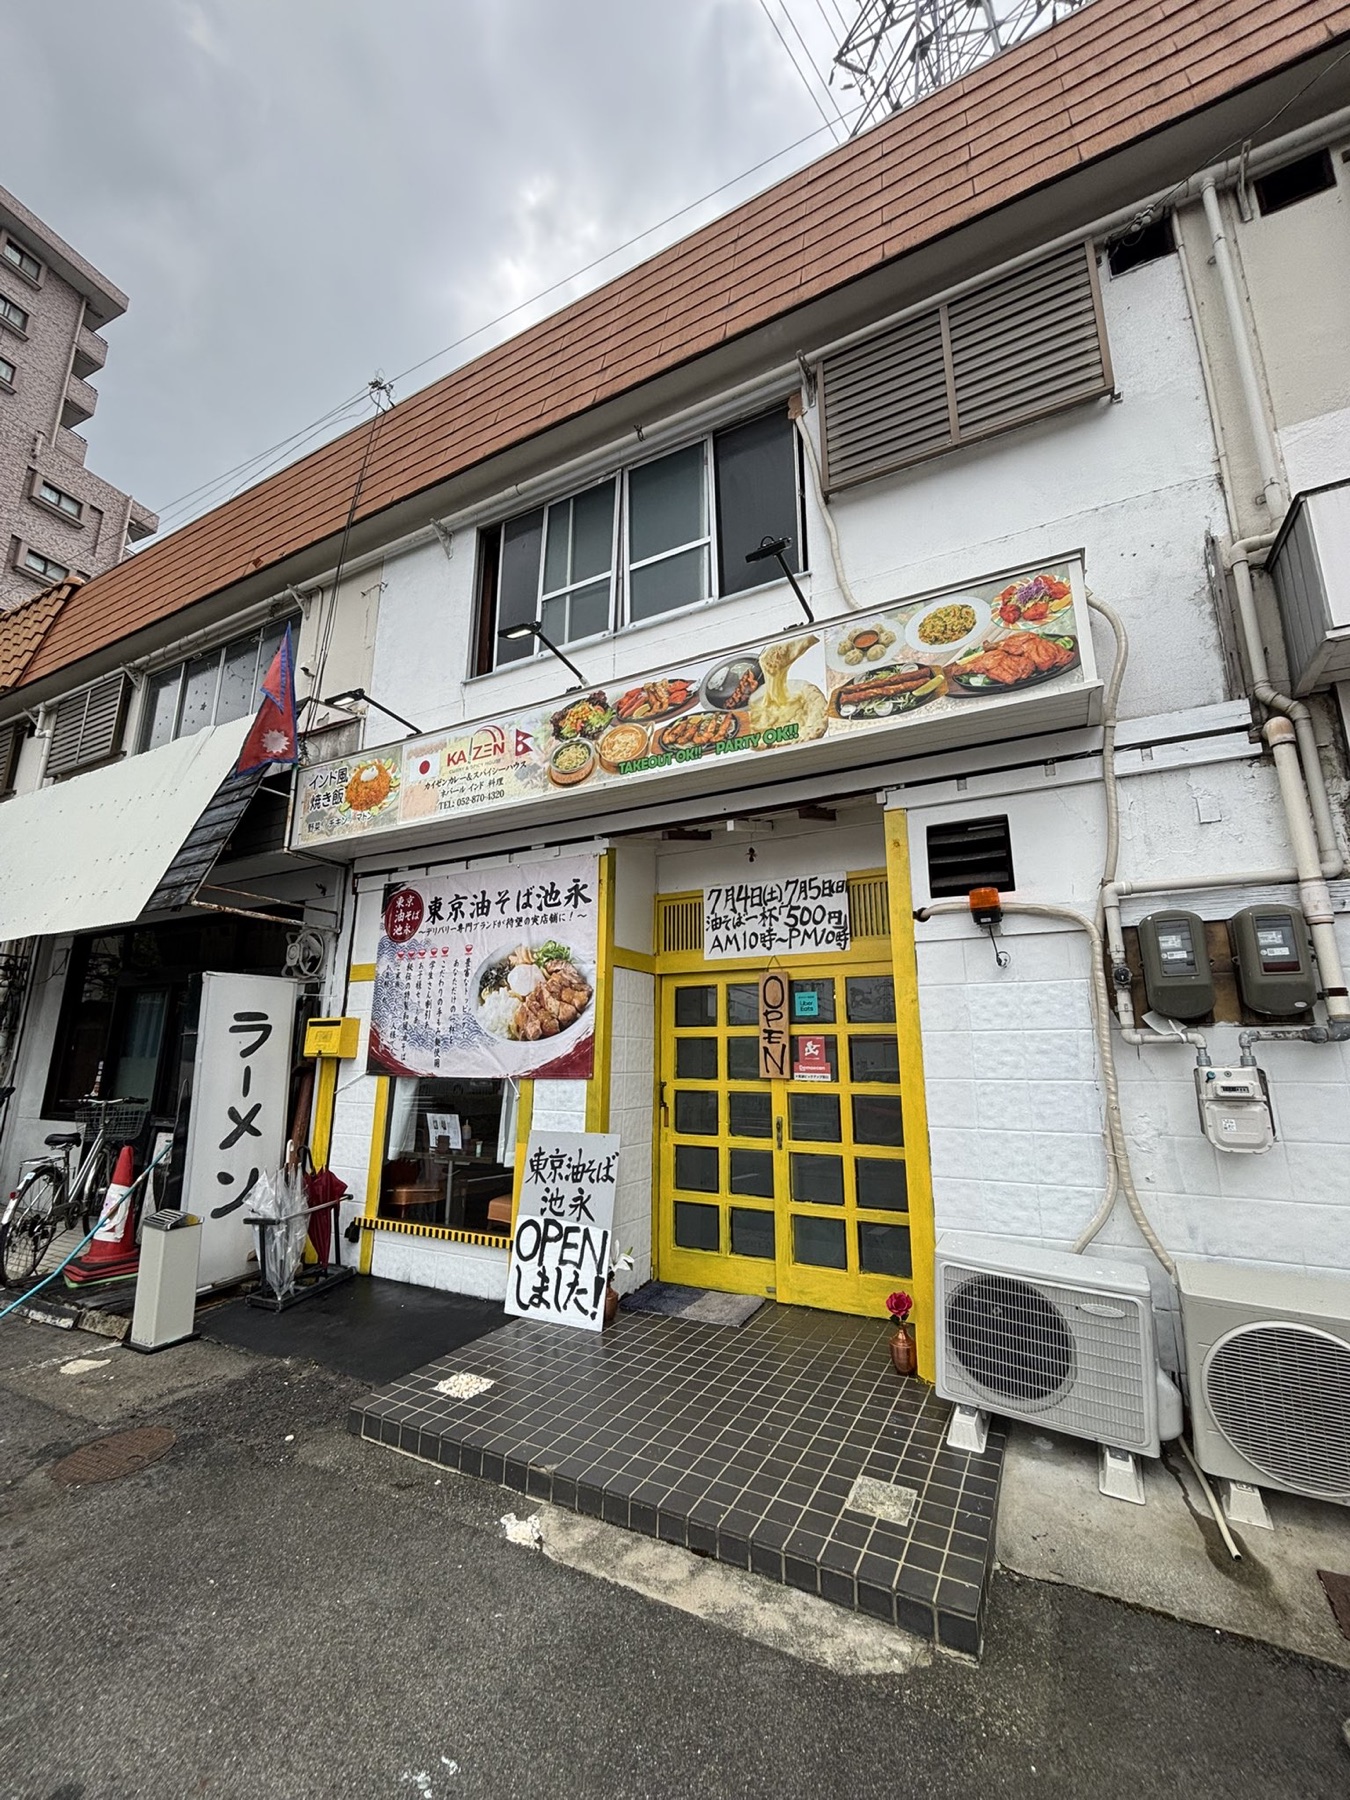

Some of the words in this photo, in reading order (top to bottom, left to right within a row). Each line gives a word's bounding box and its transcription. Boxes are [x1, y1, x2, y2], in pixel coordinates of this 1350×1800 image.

[446, 737, 505, 767] KAIZEN
[618, 753, 673, 776] TAKEOUT
[674, 745, 703, 765] OK!!
[715, 733, 762, 756] PARTY
[762, 723, 800, 745] OK!!
[309, 767, 350, 790] インド風
[488, 776, 505, 788] 料理
[310, 788, 344, 812] 焼き飯
[439, 799, 455, 811] TEL:
[308, 821, 321, 833] 野菜
[328, 816, 348, 828] チキン
[356, 812, 373, 822] マトン
[394, 909, 421, 924] 油そば
[396, 895, 415, 909] 東京
[425, 878, 592, 925] 東京油そば池永
[392, 923, 412, 937] 池永
[762, 975, 787, 1076] OPEN
[210, 1011, 272, 1219] ラーメン
[525, 1146, 620, 1184] 東京油そば
[540, 1187, 595, 1222] 池永
[515, 1218, 608, 1275] OPEN
[516, 1265, 605, 1320] しました!
